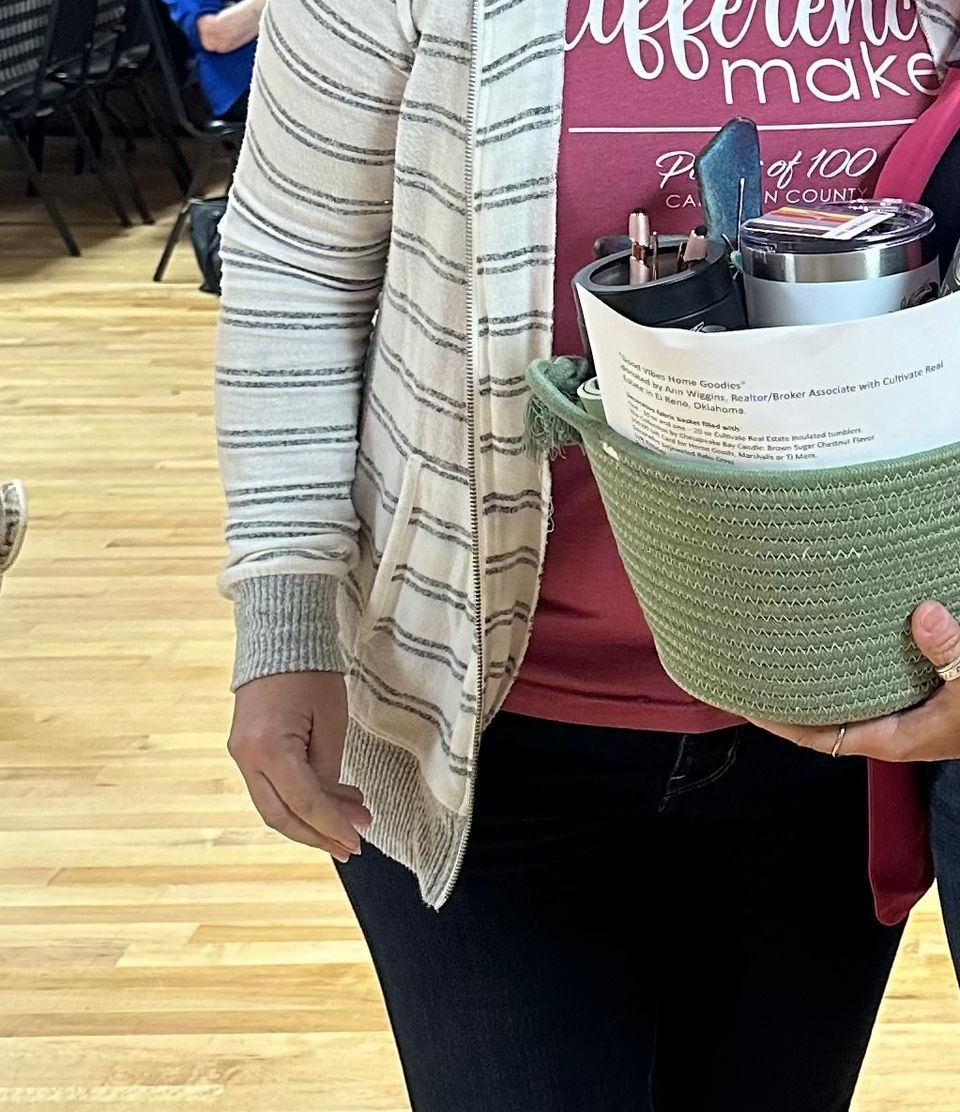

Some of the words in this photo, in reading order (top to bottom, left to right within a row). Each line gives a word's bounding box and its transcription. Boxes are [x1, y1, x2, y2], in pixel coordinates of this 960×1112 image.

[766, 150, 801, 189] of
[806, 147, 878, 179] 100
[652, 382, 663, 392] by
[665, 385, 684, 396] Ann
[686, 389, 728, 403] Wiggins,
[731, 390, 806, 403] Realtor/Broker
[808, 384, 856, 398] Associate
[859, 380, 880, 391] with
[882, 368, 923, 386] Cultivate
[925, 360, 944, 374] Real
[668, 375, 697, 387] Home
[700, 380, 746, 390] Goodies"
[694, 402, 747, 415] Oklahoma.
